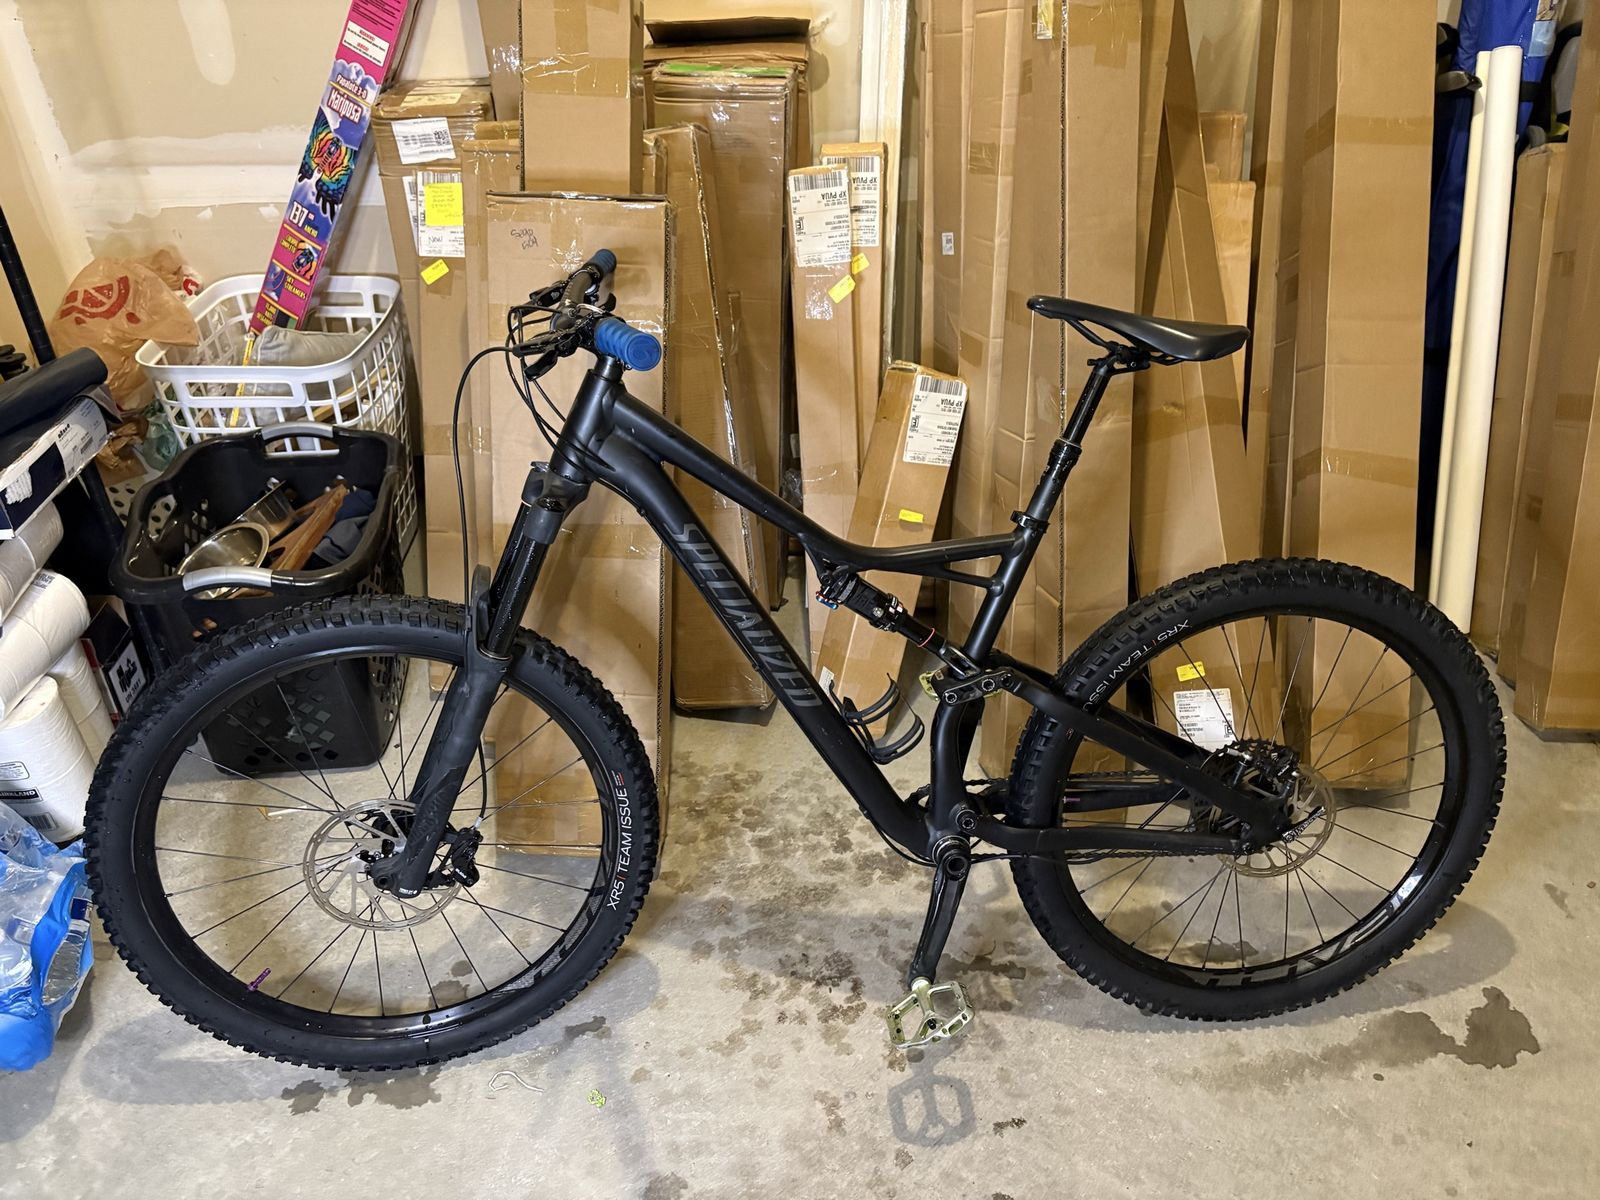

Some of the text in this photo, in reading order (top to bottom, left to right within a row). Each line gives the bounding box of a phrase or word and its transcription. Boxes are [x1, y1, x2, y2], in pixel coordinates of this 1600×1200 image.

[336, 74, 360, 94] Papalote
[328, 88, 363, 123] Mariposa
[290, 201, 309, 227] 137
[284, 282, 307, 300] STREAMERS
[663, 523, 822, 706] SPECIALIZED
[1083, 619, 1189, 711] XR5 TEAM ISSU
[616, 788, 632, 829] ISSUE
[617, 833, 632, 873] TEAM
[607, 879, 625, 910] XR5
